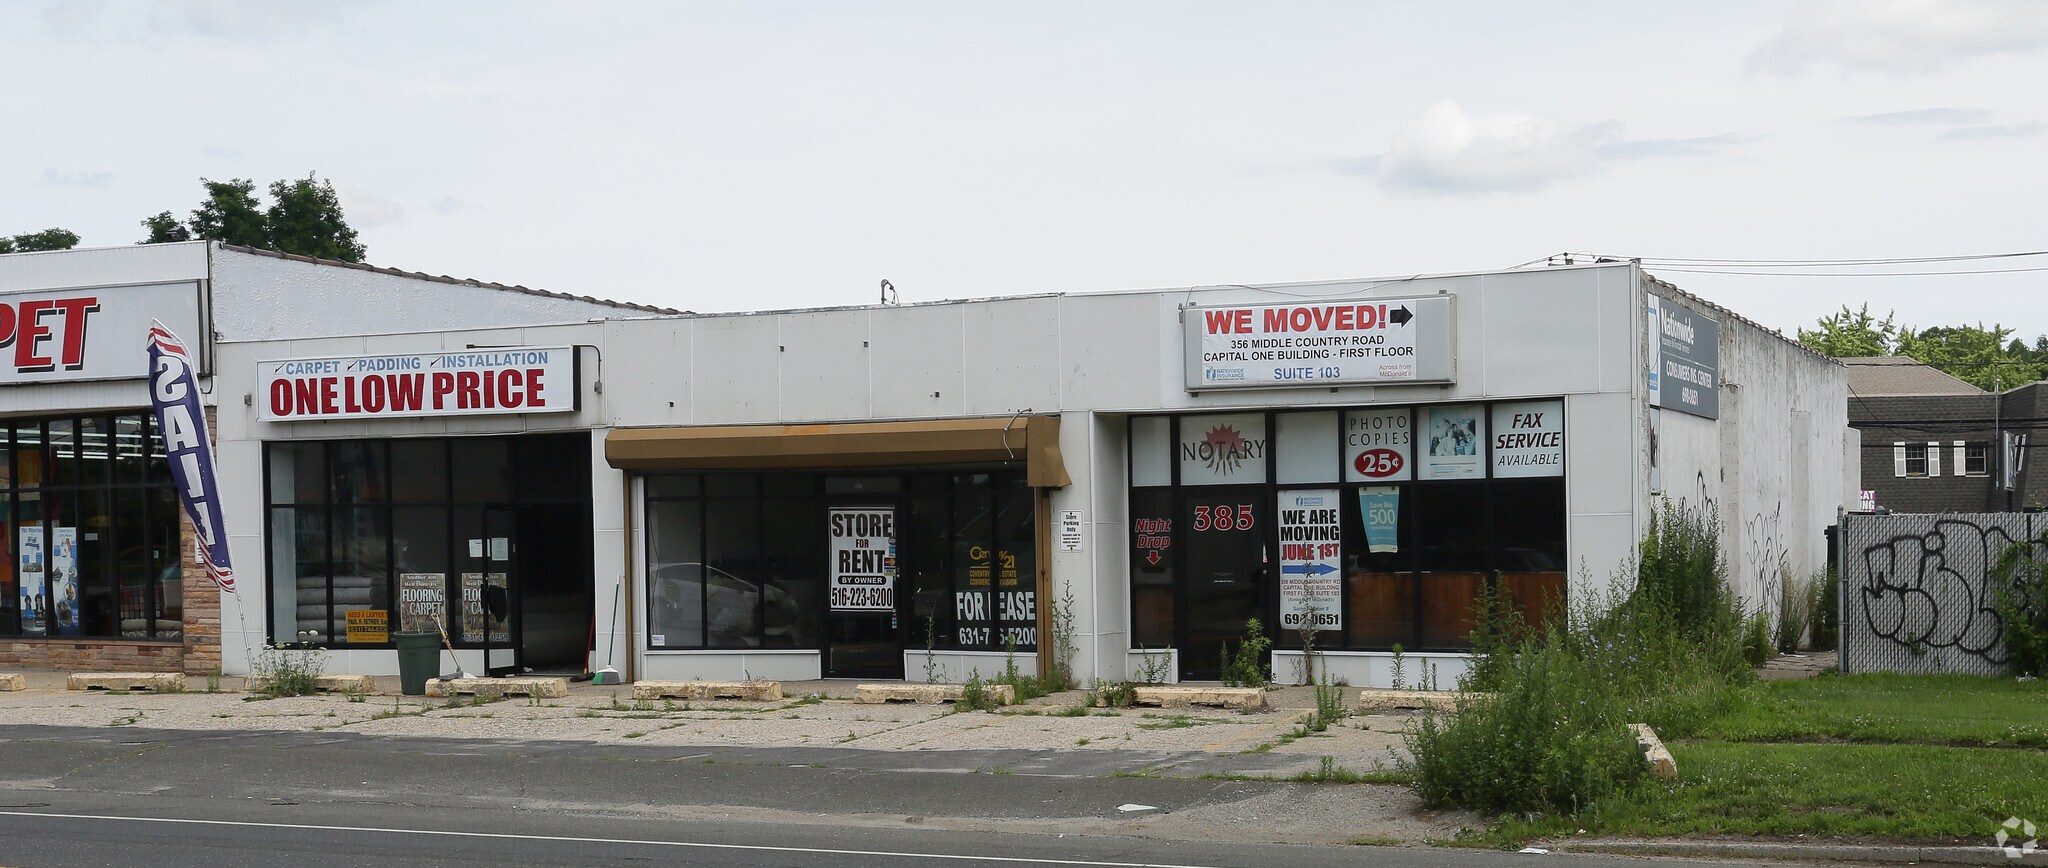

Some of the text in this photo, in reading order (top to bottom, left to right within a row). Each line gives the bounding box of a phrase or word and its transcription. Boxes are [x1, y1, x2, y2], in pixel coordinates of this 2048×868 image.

[1205, 304, 1386, 334] WE MOVED!
[1661, 308, 1694, 345] Nationwide
[1230, 335, 1384, 349] 356 MIDDLE COUNTRY ROAD
[1204, 352, 1248, 361] CAPITAL
[1251, 351, 1274, 360] ONE
[1277, 349, 1330, 359] BUILDING
[1339, 348, 1371, 357] FIRST
[1375, 347, 1413, 356] FLOOR
[285, 351, 548, 375] CARPET PADDING INSTALLATION
[1274, 366, 1340, 379] SUITE 103
[1697, 369, 1712, 389] CENTER
[270, 369, 546, 416] ONE LOW PRICE
[1350, 416, 1406, 430] PHOTO
[1512, 413, 1543, 428] FAX
[1349, 432, 1409, 446] COPIES
[1496, 432, 1561, 449] SERVICE
[1182, 440, 1265, 461] NOTARY
[1498, 453, 1560, 466] AVAILABLE
[831, 513, 892, 537] STORE
[1193, 504, 1255, 531] 385
[1282, 509, 1337, 525] WE ARE
[1369, 509, 1395, 525] 500
[1135, 518, 1172, 534] Night
[1280, 526, 1339, 541] MOVING
[855, 539, 869, 548] FOR
[1137, 534, 1170, 550] Drop
[969, 546, 1007, 560] Cenry
[1282, 543, 1339, 560] JUNE 1ST
[838, 550, 886, 573] RENT
[1003, 555, 1015, 568] 21
[402, 588, 443, 602] FLOORING
[831, 587, 892, 607] 516-223-6200
[409, 602, 442, 615] CARPET
[956, 592, 985, 620] FOR
[1285, 614, 1339, 625] 690651
[959, 627, 1036, 645] 631-76-5200
